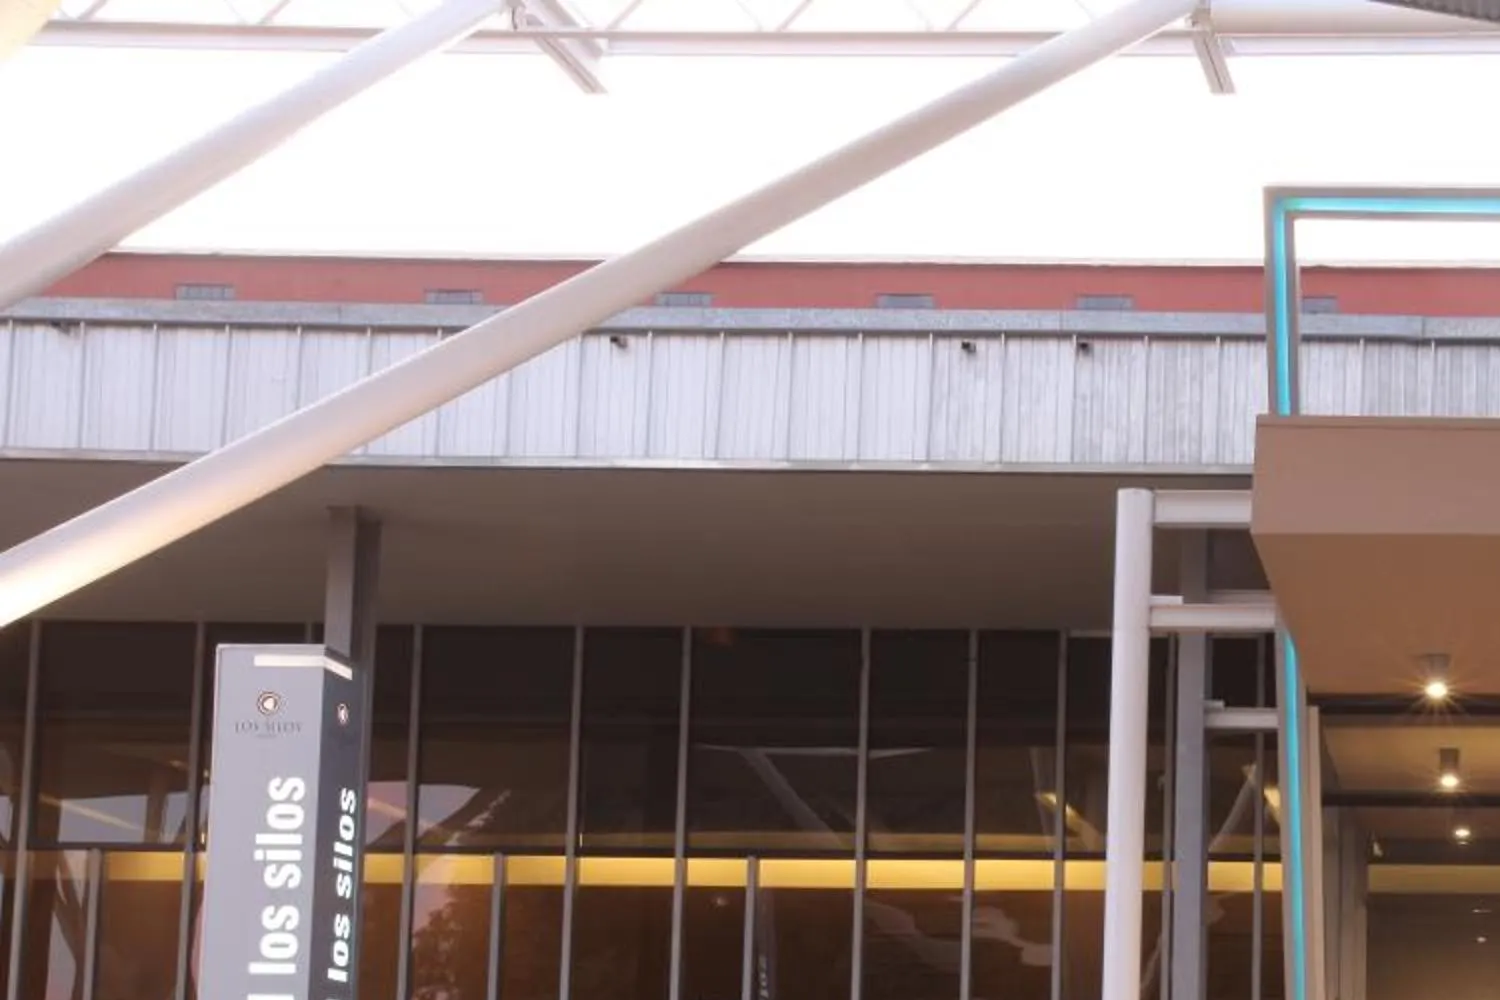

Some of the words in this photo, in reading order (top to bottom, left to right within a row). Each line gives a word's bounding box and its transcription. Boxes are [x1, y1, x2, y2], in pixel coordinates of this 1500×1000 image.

[253, 776, 306, 889] silos
[333, 787, 356, 898] silos
[248, 905, 300, 975] los
[327, 913, 350, 982] los
